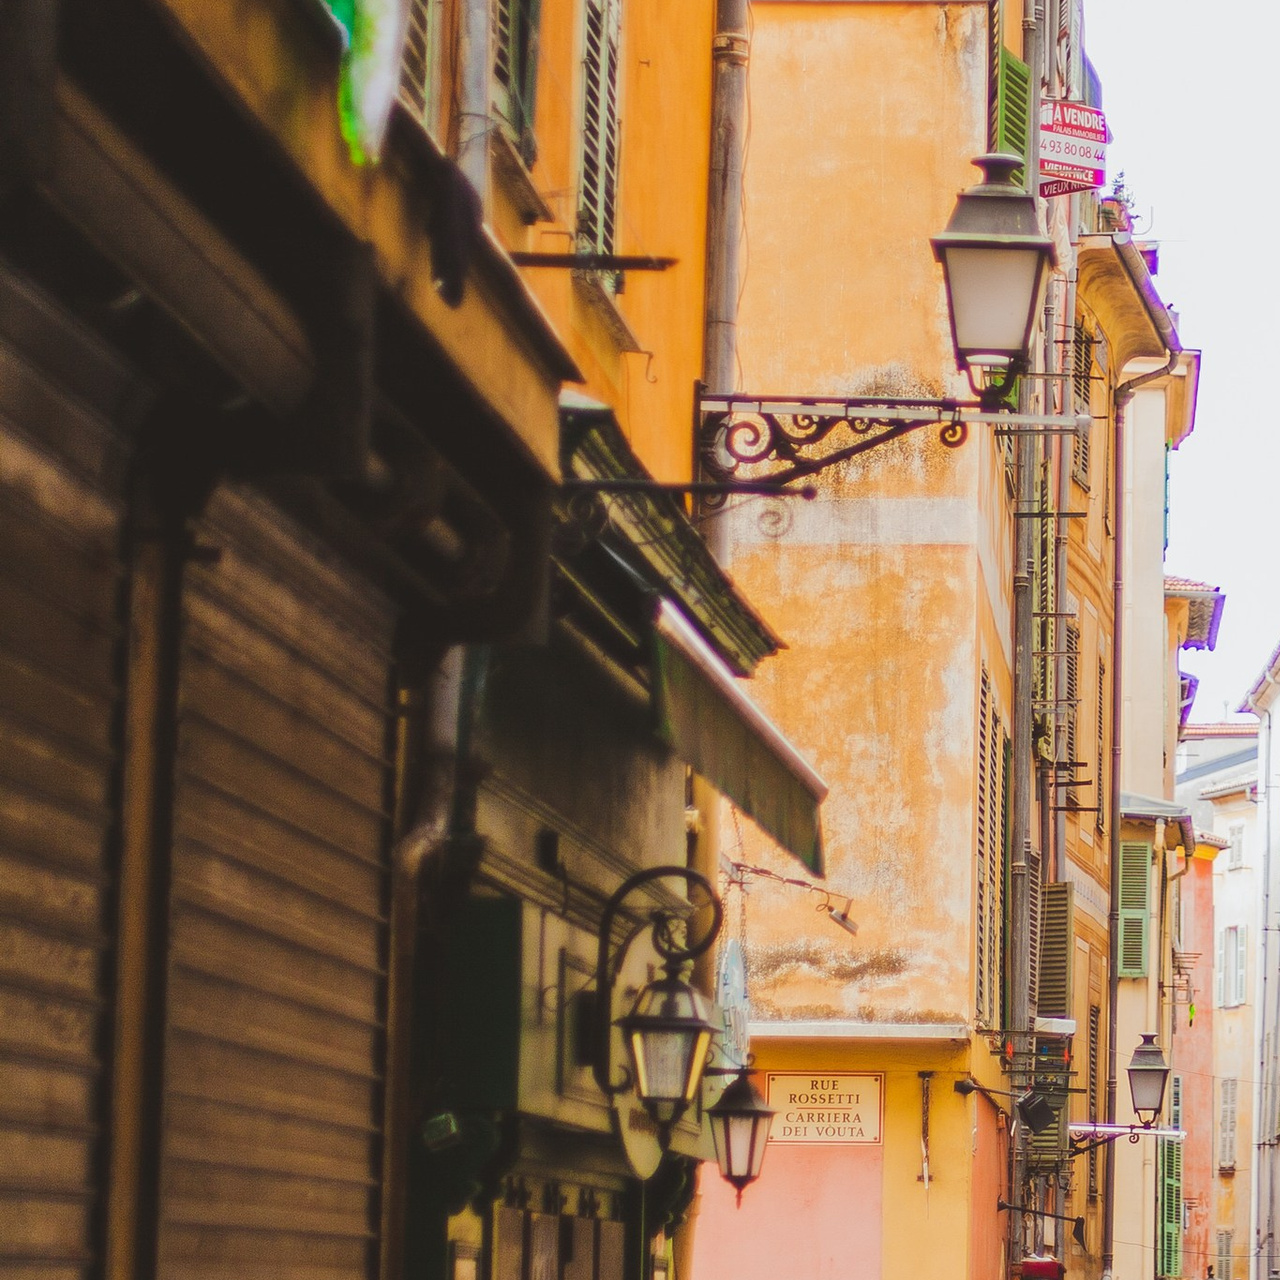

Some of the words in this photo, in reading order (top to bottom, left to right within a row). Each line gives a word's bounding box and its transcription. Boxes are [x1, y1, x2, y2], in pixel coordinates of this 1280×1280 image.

[1063, 107, 1105, 132] VENDRE
[1053, 124, 1072, 136] PALAIS
[1072, 128, 1106, 142] IMMOBILIER
[1049, 140, 1062, 154] 93
[1064, 142, 1077, 156] 80
[1079, 146, 1092, 159] 08
[1094, 149, 1106, 163] 44
[1044, 181, 1069, 195] VIEUX
[810, 1079, 839, 1091] RUE
[789, 1093, 860, 1105] ROSSETTI
[785, 1111, 862, 1123] CARRIERA
[782, 1126, 808, 1137] DEI
[816, 1124, 865, 1137] VÒUTA
